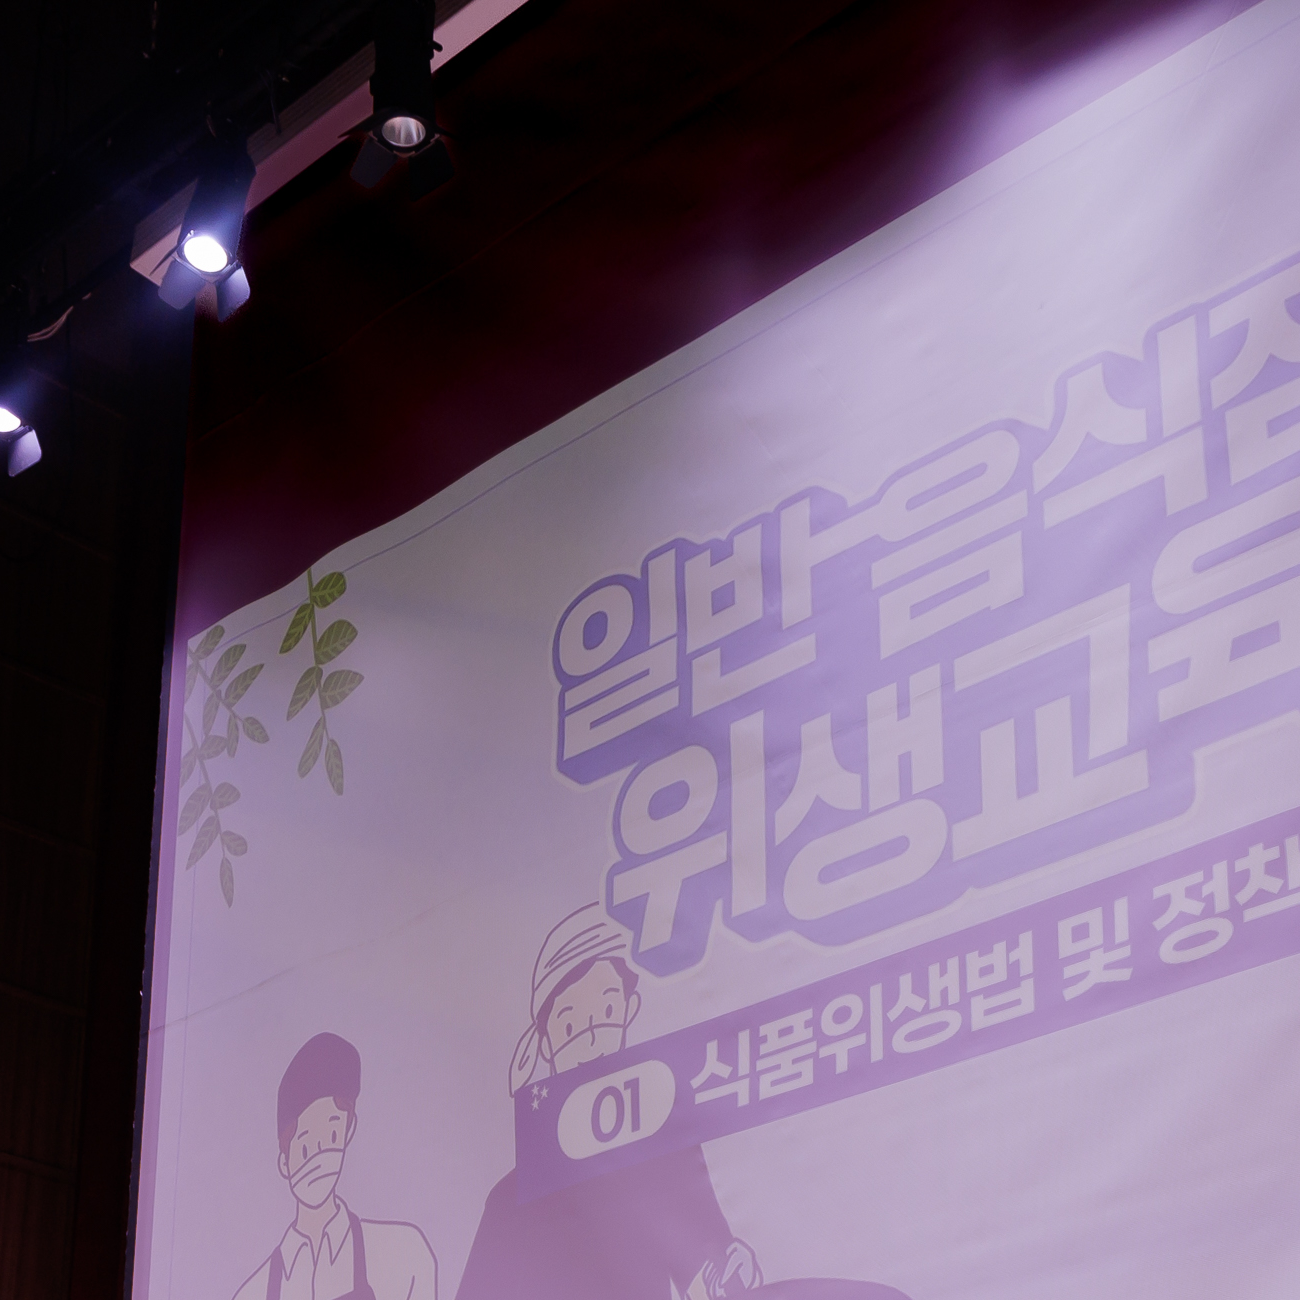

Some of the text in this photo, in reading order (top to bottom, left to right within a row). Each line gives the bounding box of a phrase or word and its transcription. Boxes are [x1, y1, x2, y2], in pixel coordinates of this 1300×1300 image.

[689, 930, 1036, 1109] 식품위생법
[1057, 895, 1134, 1002] 및
[590, 1075, 642, 1144] 01
